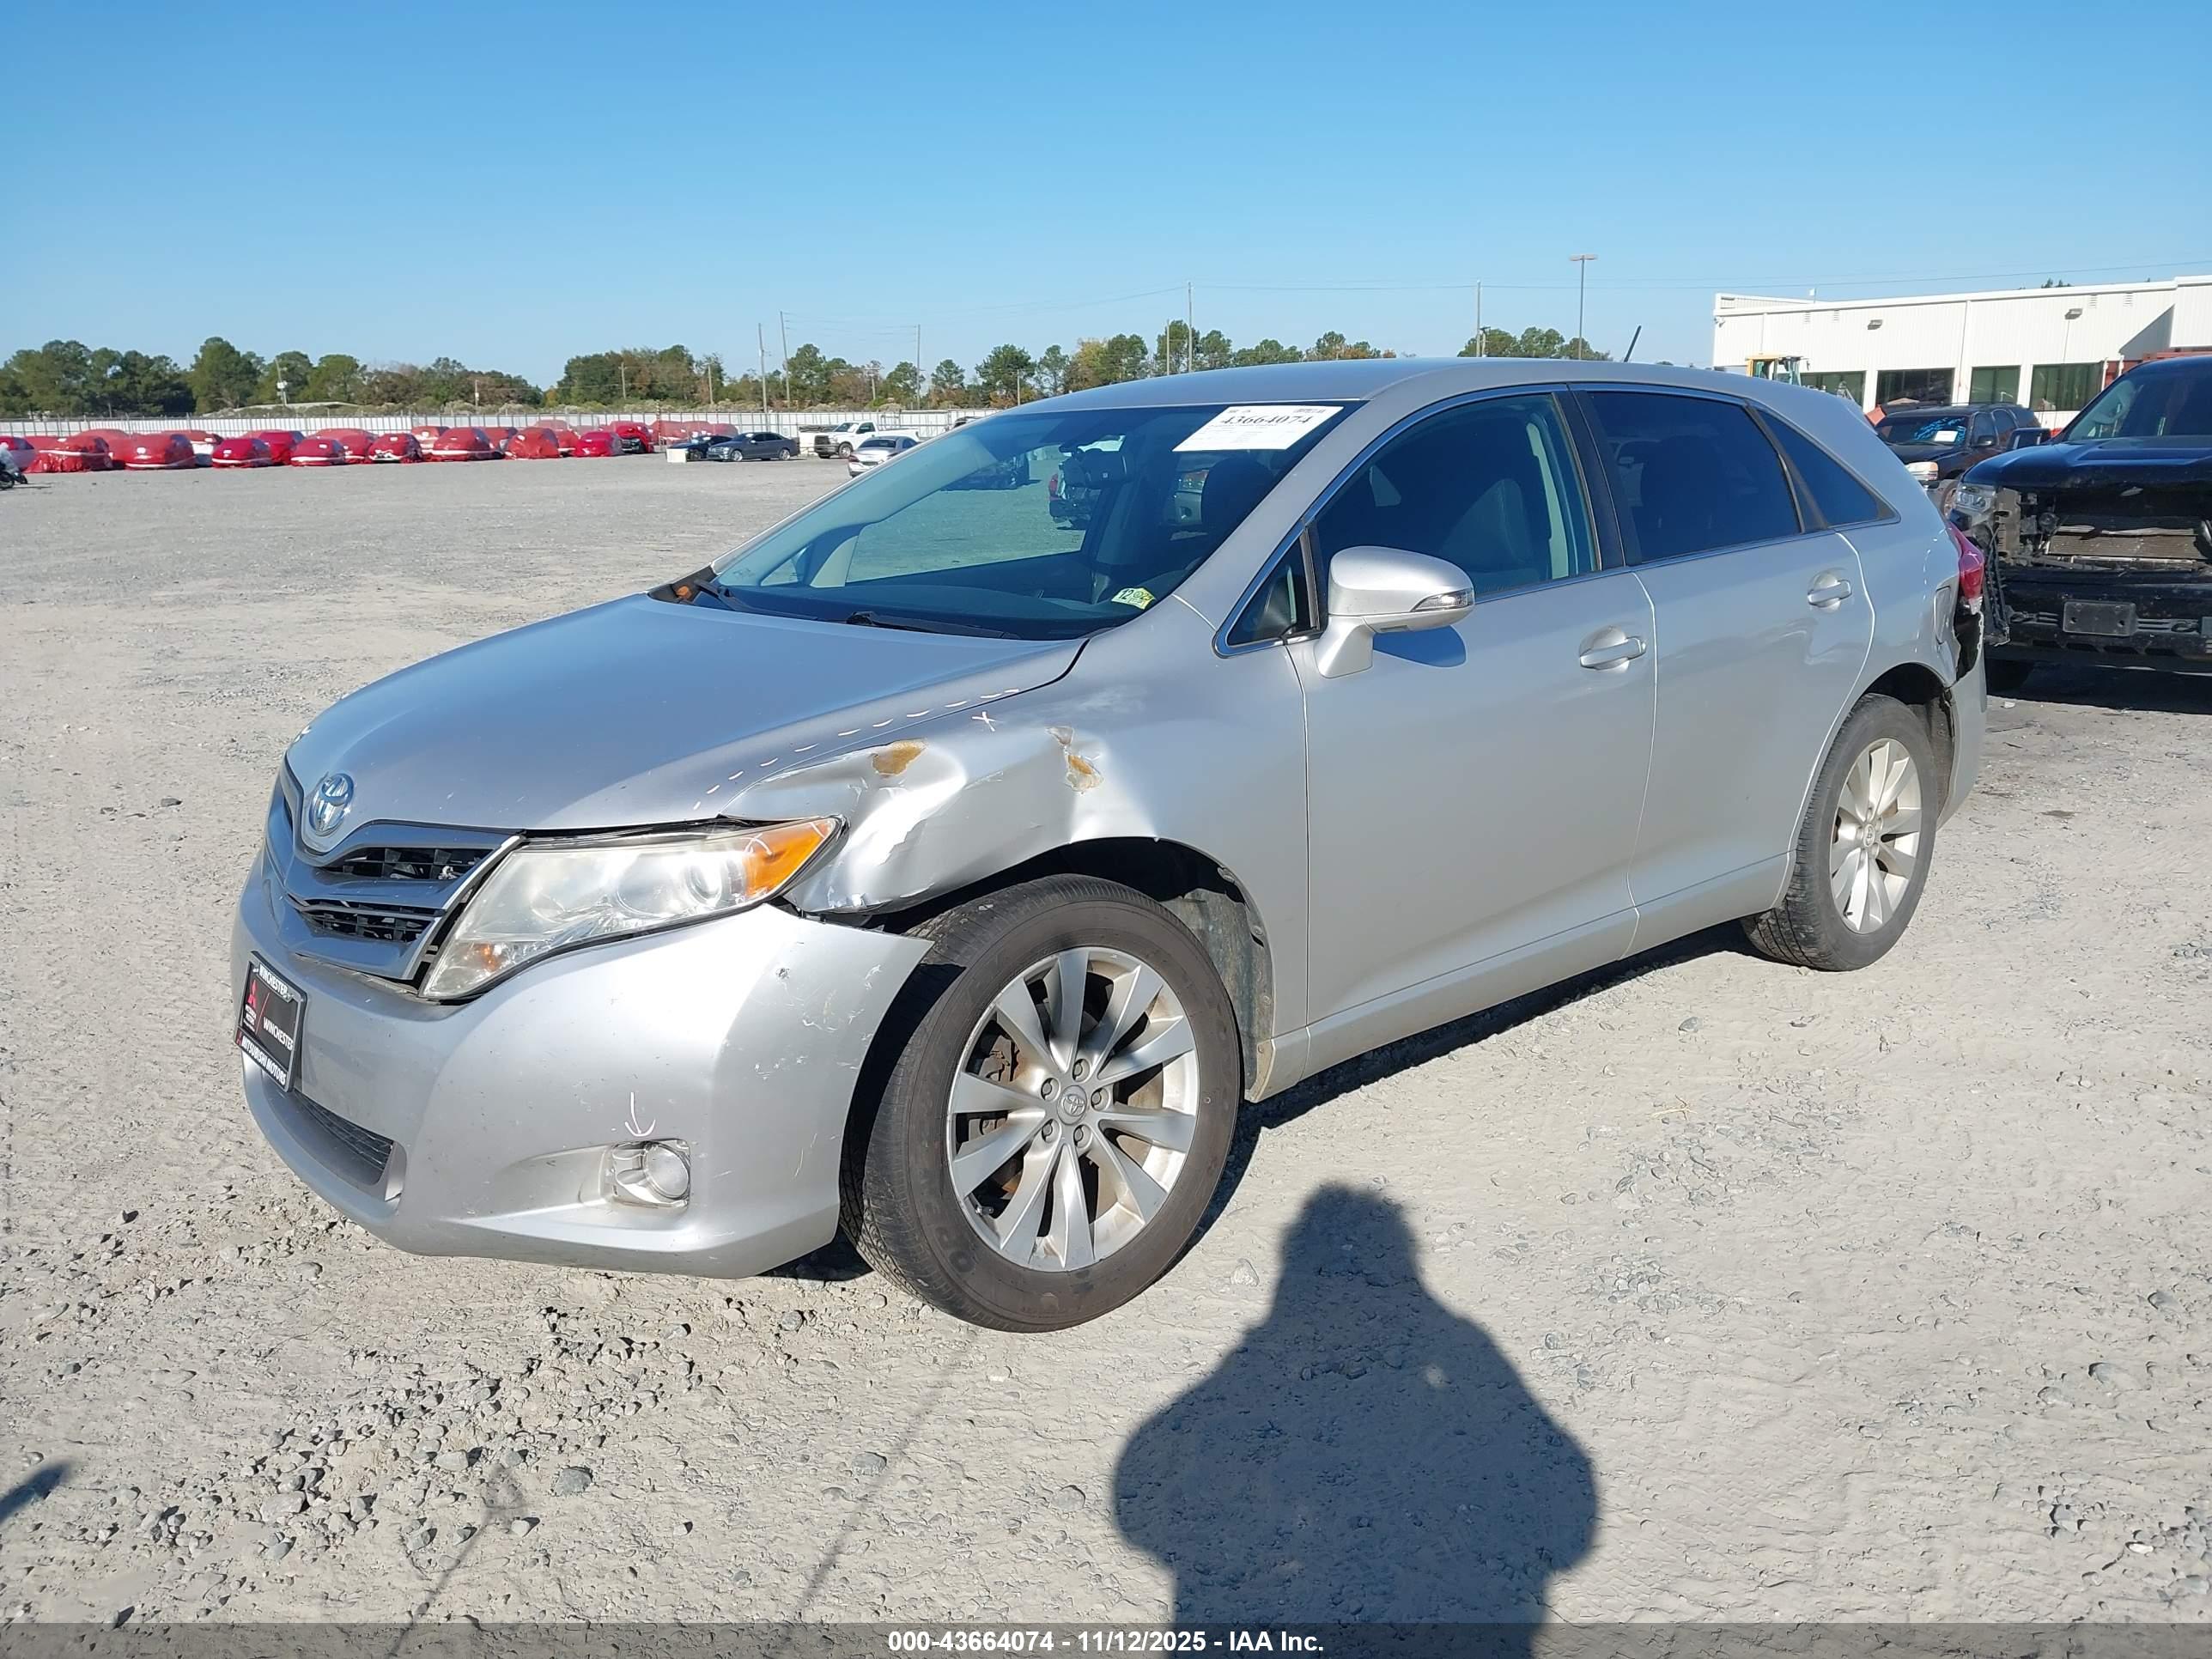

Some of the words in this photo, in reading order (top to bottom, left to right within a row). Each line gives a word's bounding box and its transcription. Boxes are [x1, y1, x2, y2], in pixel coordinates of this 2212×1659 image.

[1220, 416, 1312, 425] 43664074
[241, 1035, 268, 1067] MITSUBISHI
[266, 1058, 287, 1086] MOTORS
